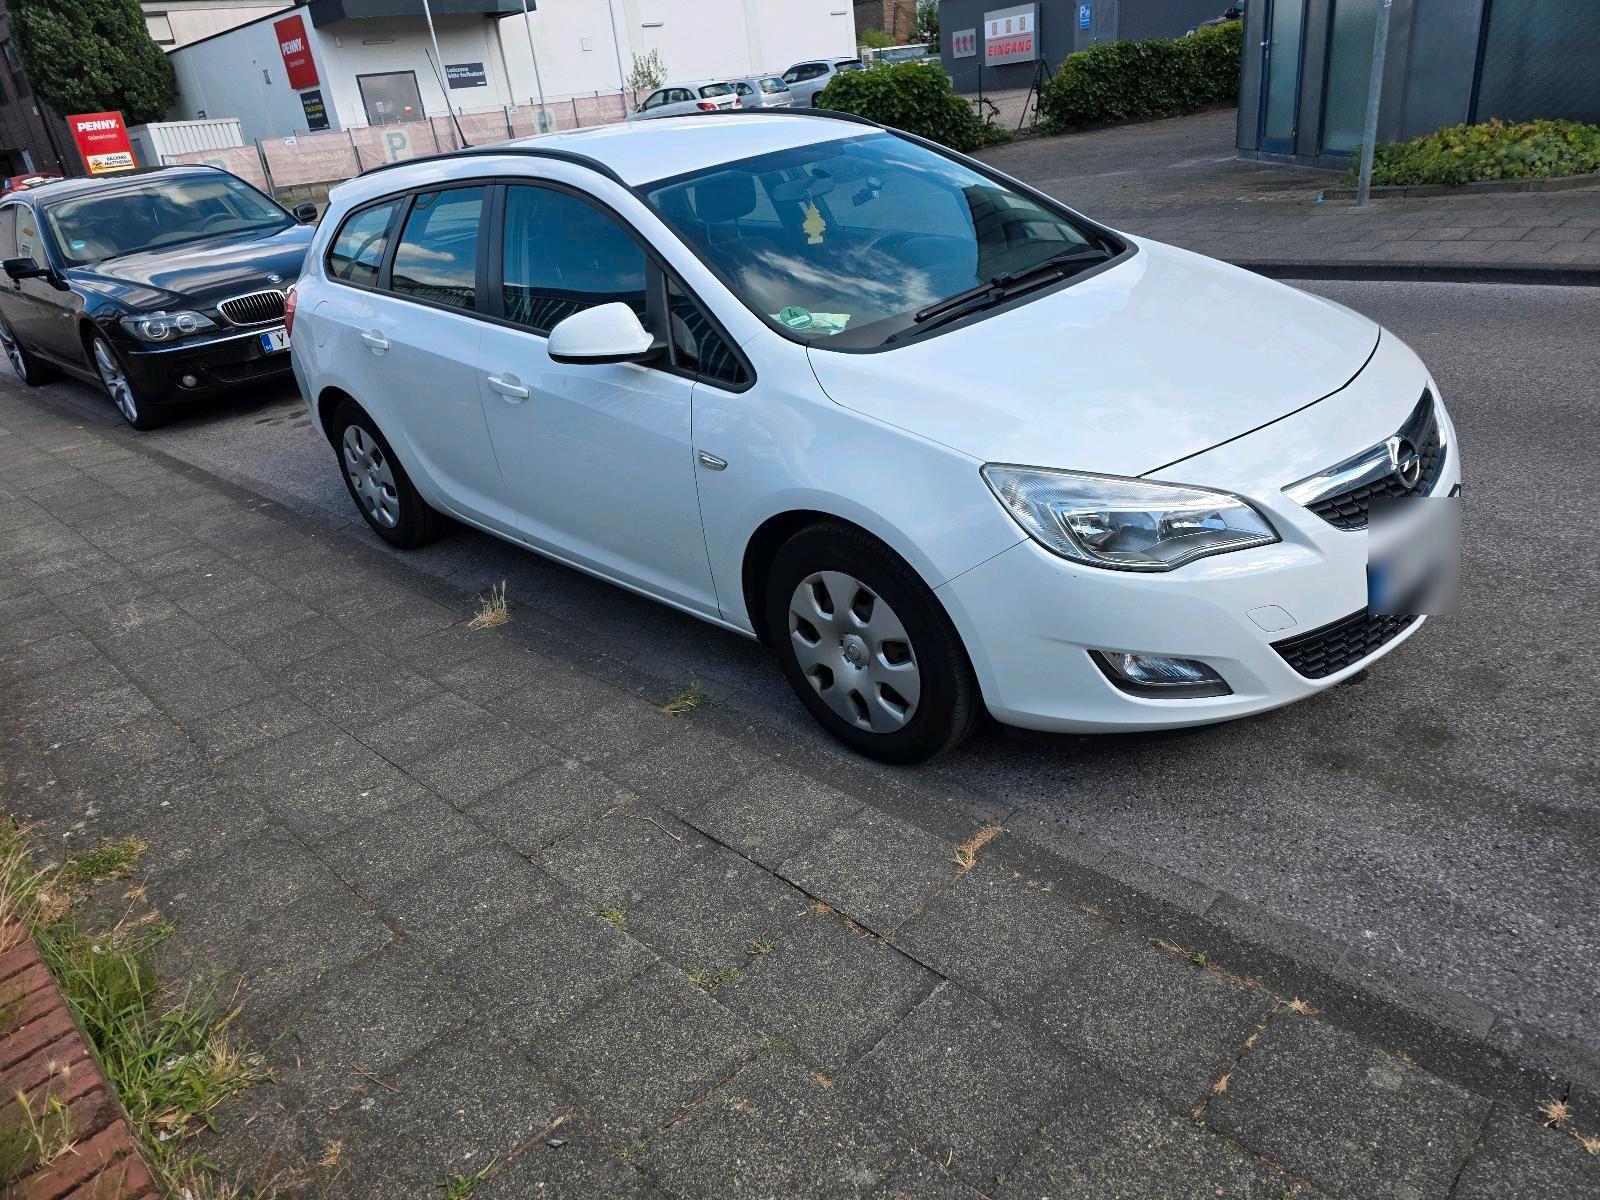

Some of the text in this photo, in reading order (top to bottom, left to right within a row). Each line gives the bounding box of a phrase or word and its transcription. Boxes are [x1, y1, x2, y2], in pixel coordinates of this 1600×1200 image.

[988, 40, 1032, 56] EINGANG
[386, 132, 407, 160] P
[276, 332, 284, 346] Y
